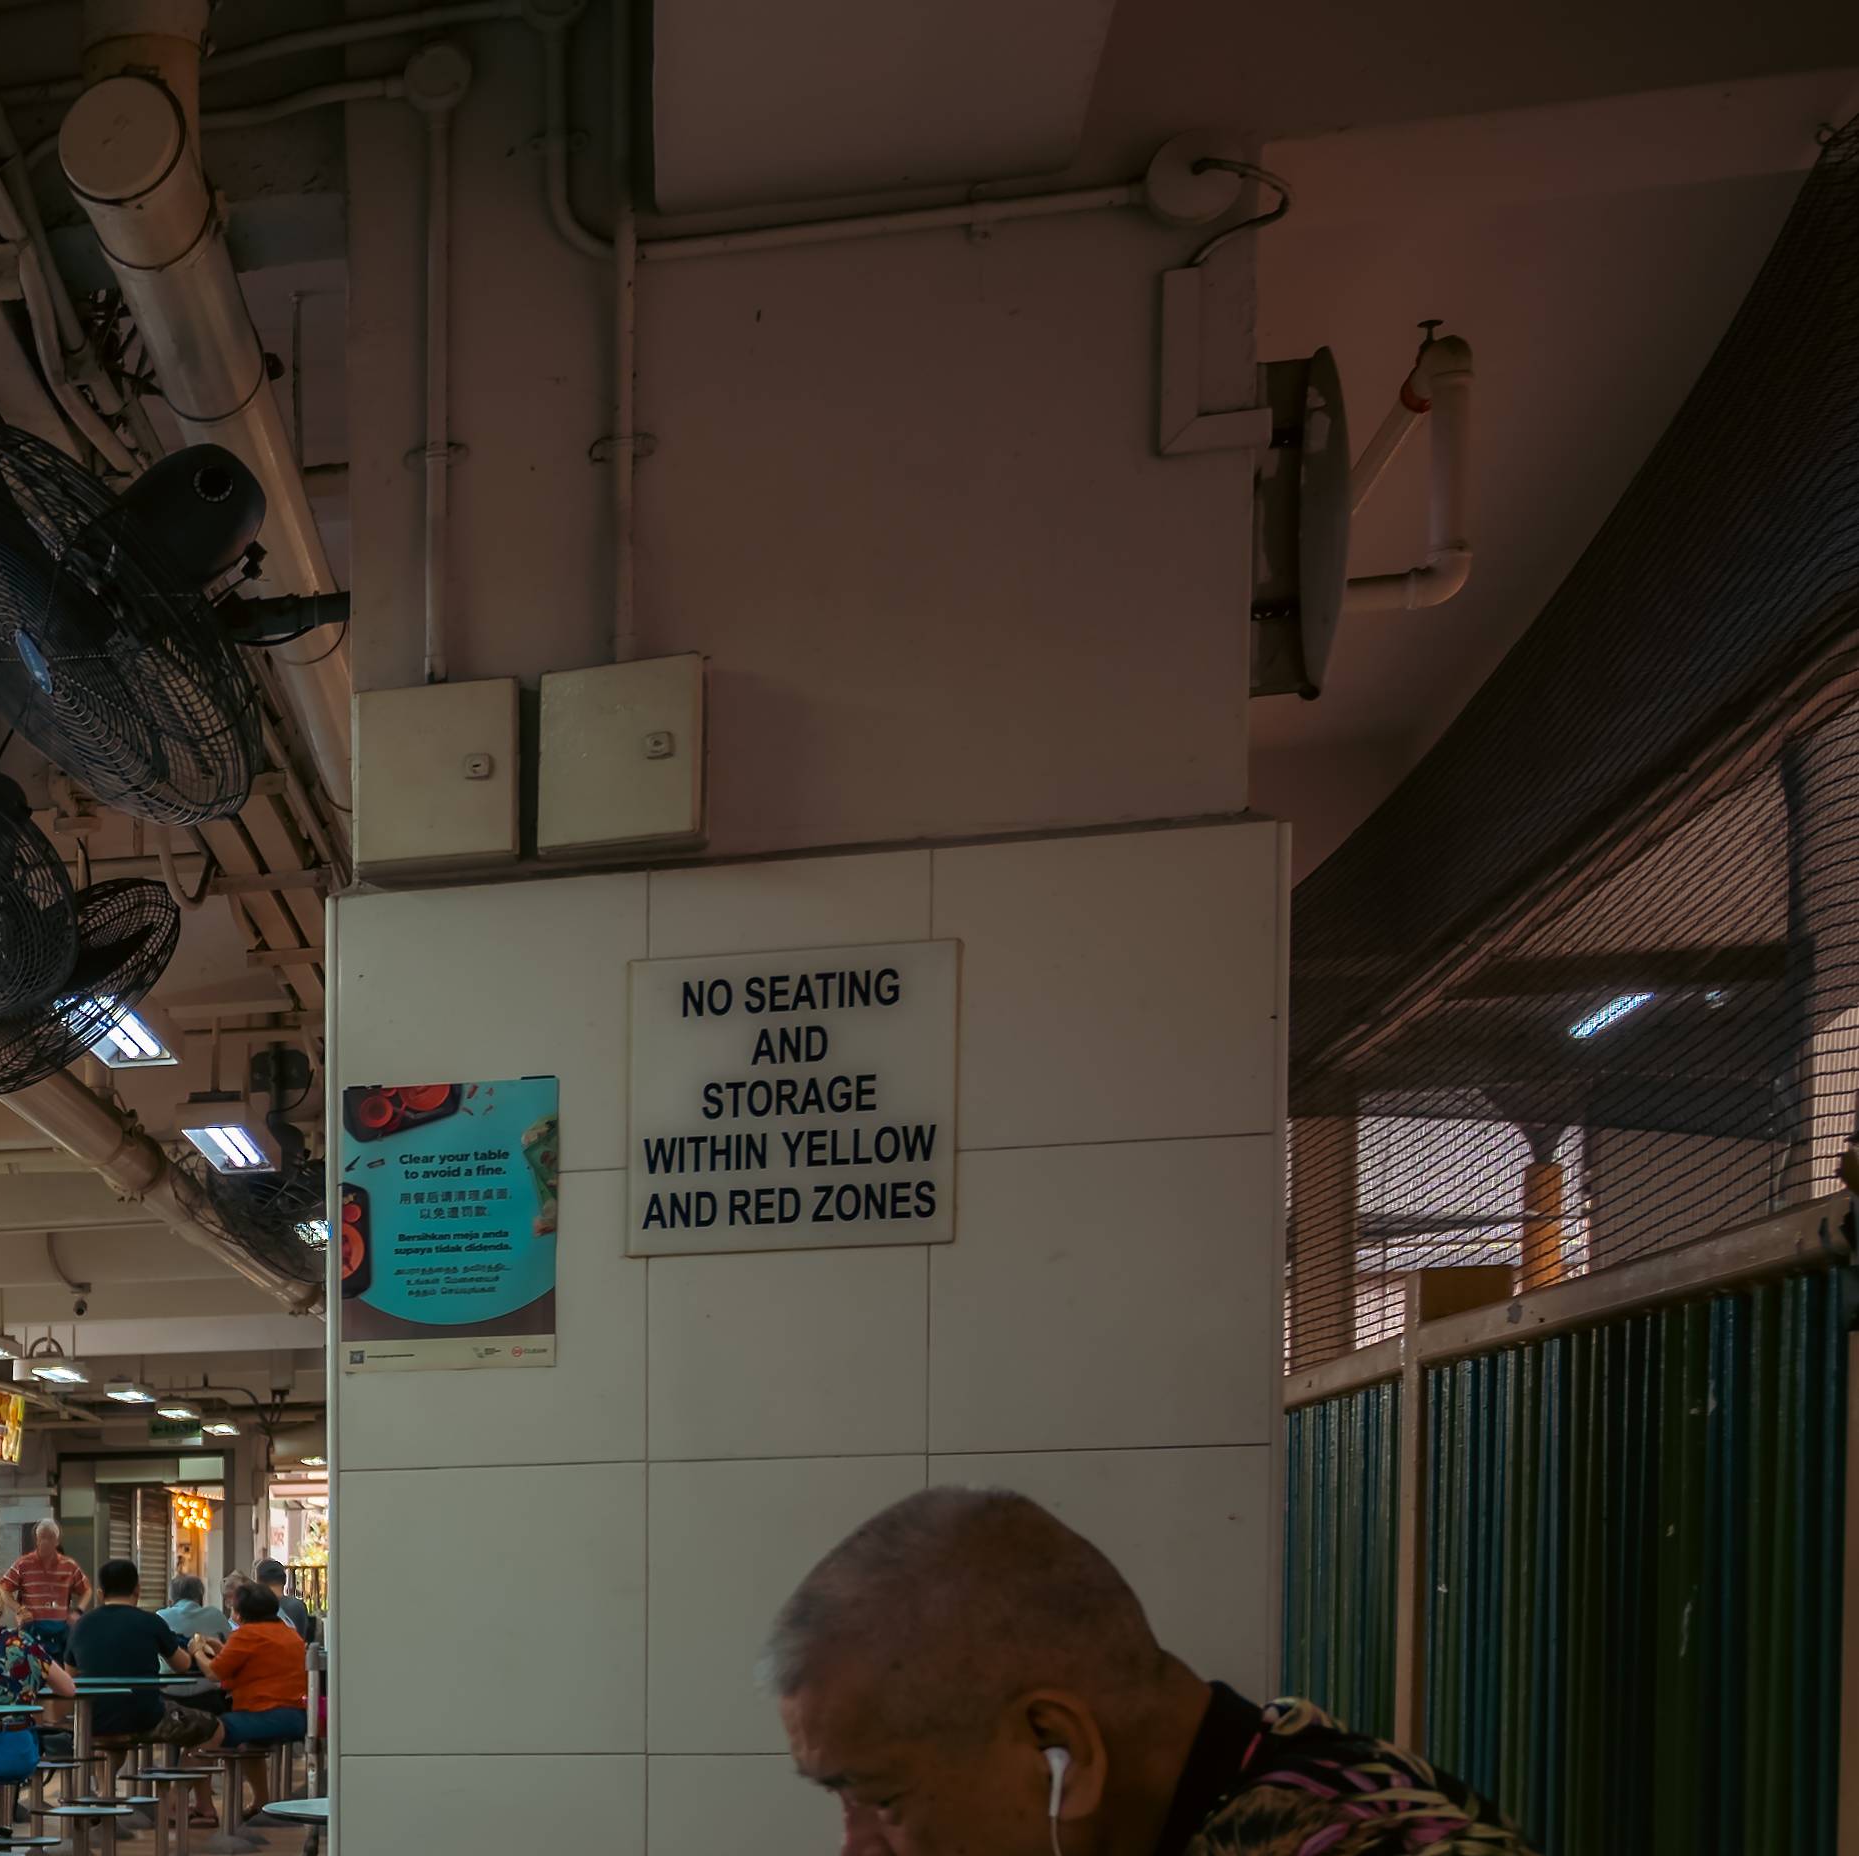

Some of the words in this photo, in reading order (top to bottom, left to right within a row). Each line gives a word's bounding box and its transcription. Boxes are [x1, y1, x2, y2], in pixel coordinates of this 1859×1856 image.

[682, 979, 732, 1017] NO
[744, 968, 900, 1014] SEATING
[751, 1025, 828, 1065] AND
[702, 1074, 877, 1119] STORAGE
[398, 1153, 435, 1166] Clear
[438, 1150, 471, 1165] your
[473, 1148, 511, 1161] table
[643, 1133, 767, 1174] WITHIN
[781, 1124, 937, 1167] YELLOW
[403, 1167, 420, 1180] to
[421, 1165, 462, 1179] avoid
[463, 1168, 474, 1178] a
[475, 1164, 507, 1176] fine.
[642, 1191, 717, 1229] AND
[729, 1186, 800, 1226] RED
[812, 1180, 936, 1222] ZONES
[393, 1244, 432, 1257] supaya
[434, 1242, 463, 1255] tidak
[397, 1231, 451, 1243] Bersihkan
[452, 1230, 480, 1242] meja
[481, 1229, 510, 1240] anda
